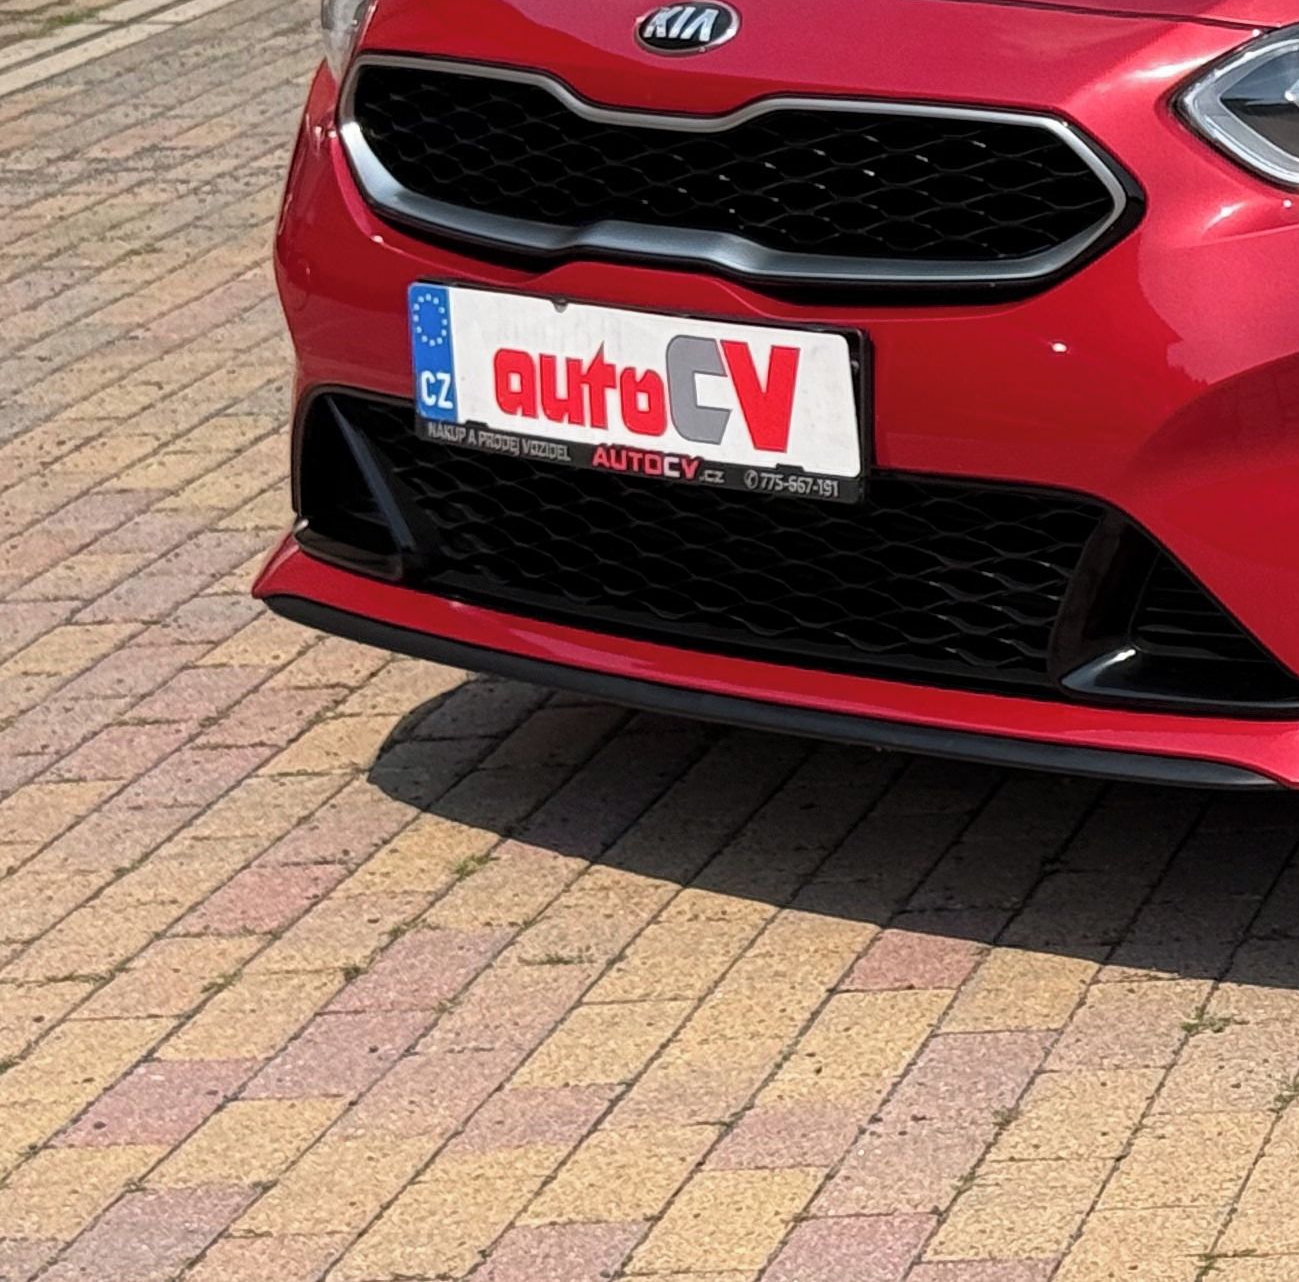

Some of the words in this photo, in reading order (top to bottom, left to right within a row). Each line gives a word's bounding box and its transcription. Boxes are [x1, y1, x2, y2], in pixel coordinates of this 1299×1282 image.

[643, 6, 720, 42] KIA
[420, 369, 454, 410] CZ
[468, 428, 478, 446] A
[478, 430, 520, 457] PRODEJ
[521, 438, 572, 462] VOZIDEL
